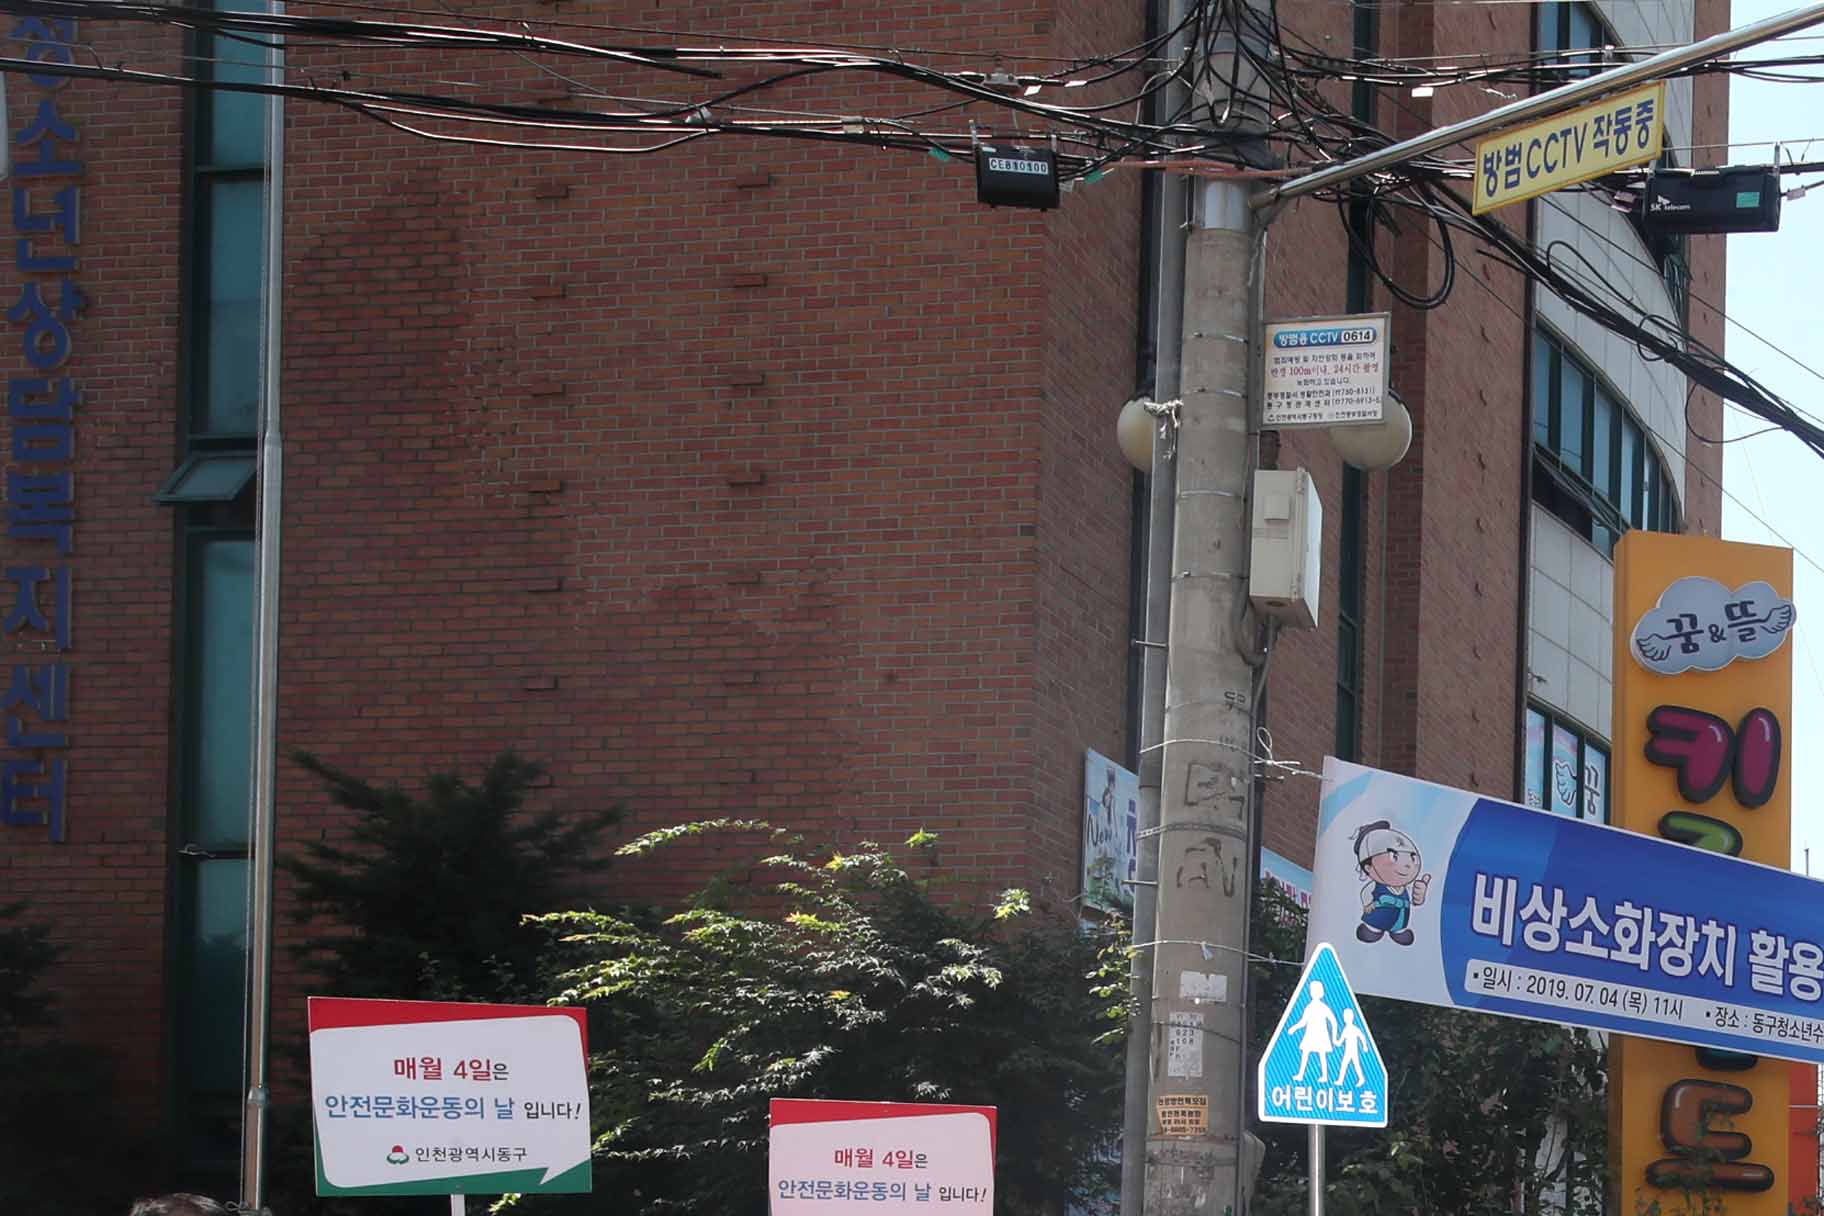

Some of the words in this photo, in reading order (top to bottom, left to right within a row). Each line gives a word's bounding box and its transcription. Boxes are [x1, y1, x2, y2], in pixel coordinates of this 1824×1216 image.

[1484, 142, 1523, 197] 방범
[1526, 122, 1588, 178] CCTV
[1593, 99, 1654, 158] 작동중
[1310, 332, 1338, 344] CCTV
[1343, 330, 1371, 342] 0614
[1472, 873, 1738, 988] 비상소화장치
[1483, 966, 1513, 998] 일시
[1599, 987, 1619, 1008] 04
[1622, 989, 1648, 1016] (목)
[1654, 995, 1684, 1021] 11시
[1714, 1007, 1741, 1030] 장소
[394, 1057, 442, 1081] 매월
[453, 1059, 510, 1082] 4일은
[325, 1095, 485, 1120] 안전문화운동의
[494, 1097, 515, 1120] 날
[523, 1101, 582, 1121] 입니다!
[1272, 1085, 1379, 1115] 어린이보호
[415, 1147, 528, 1162] 인천광역시동구
[833, 1148, 874, 1169] 매월
[882, 1150, 929, 1170] 4일은
[778, 1179, 907, 1201] 안전문화운동의
[914, 1183, 932, 1201] 날
[938, 1186, 988, 1203] 입니다!
